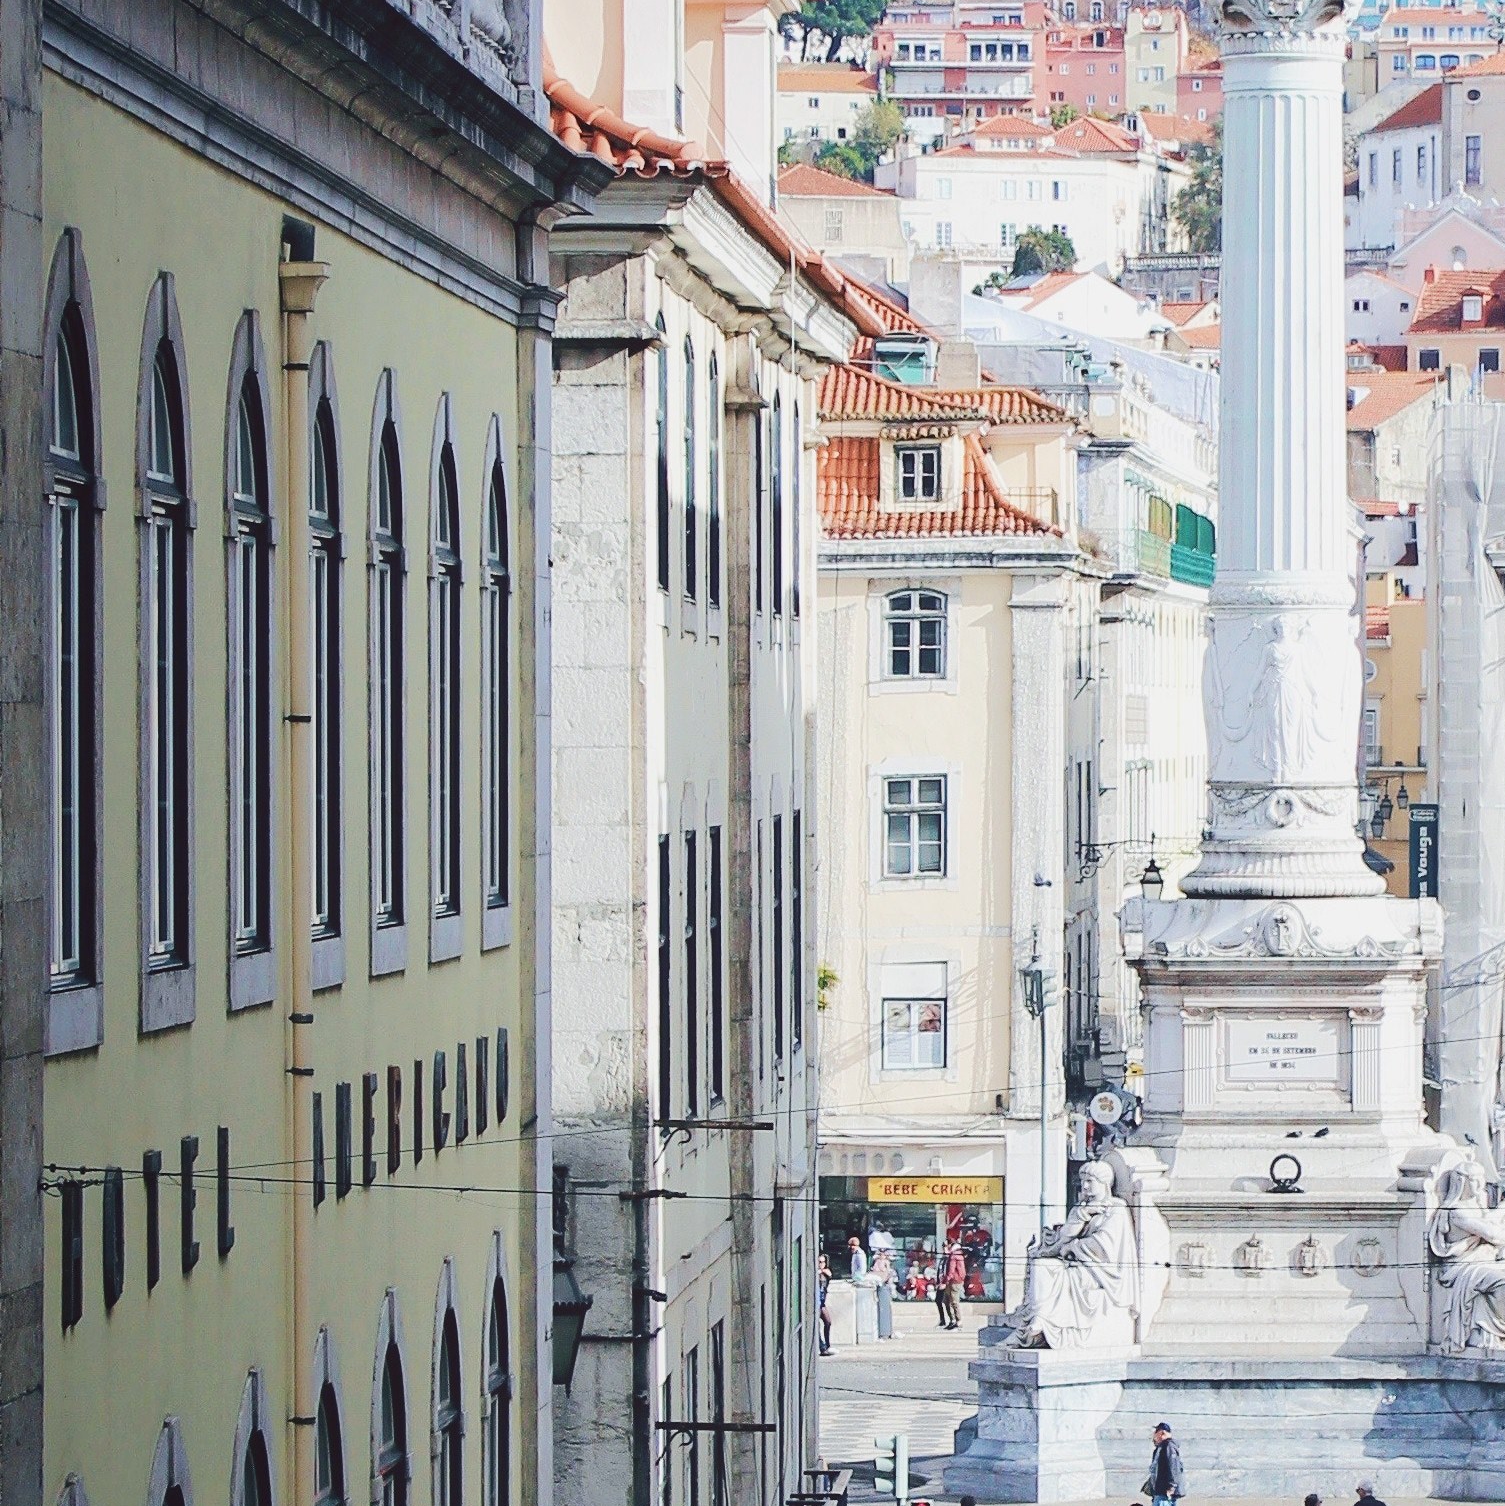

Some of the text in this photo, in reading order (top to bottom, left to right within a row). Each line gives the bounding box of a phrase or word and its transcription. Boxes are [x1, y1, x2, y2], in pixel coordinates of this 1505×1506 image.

[1417, 826, 1432, 877] Vouga
[312, 1027, 509, 1207] AMERICANO
[61, 1125, 235, 1333] HOTEL
